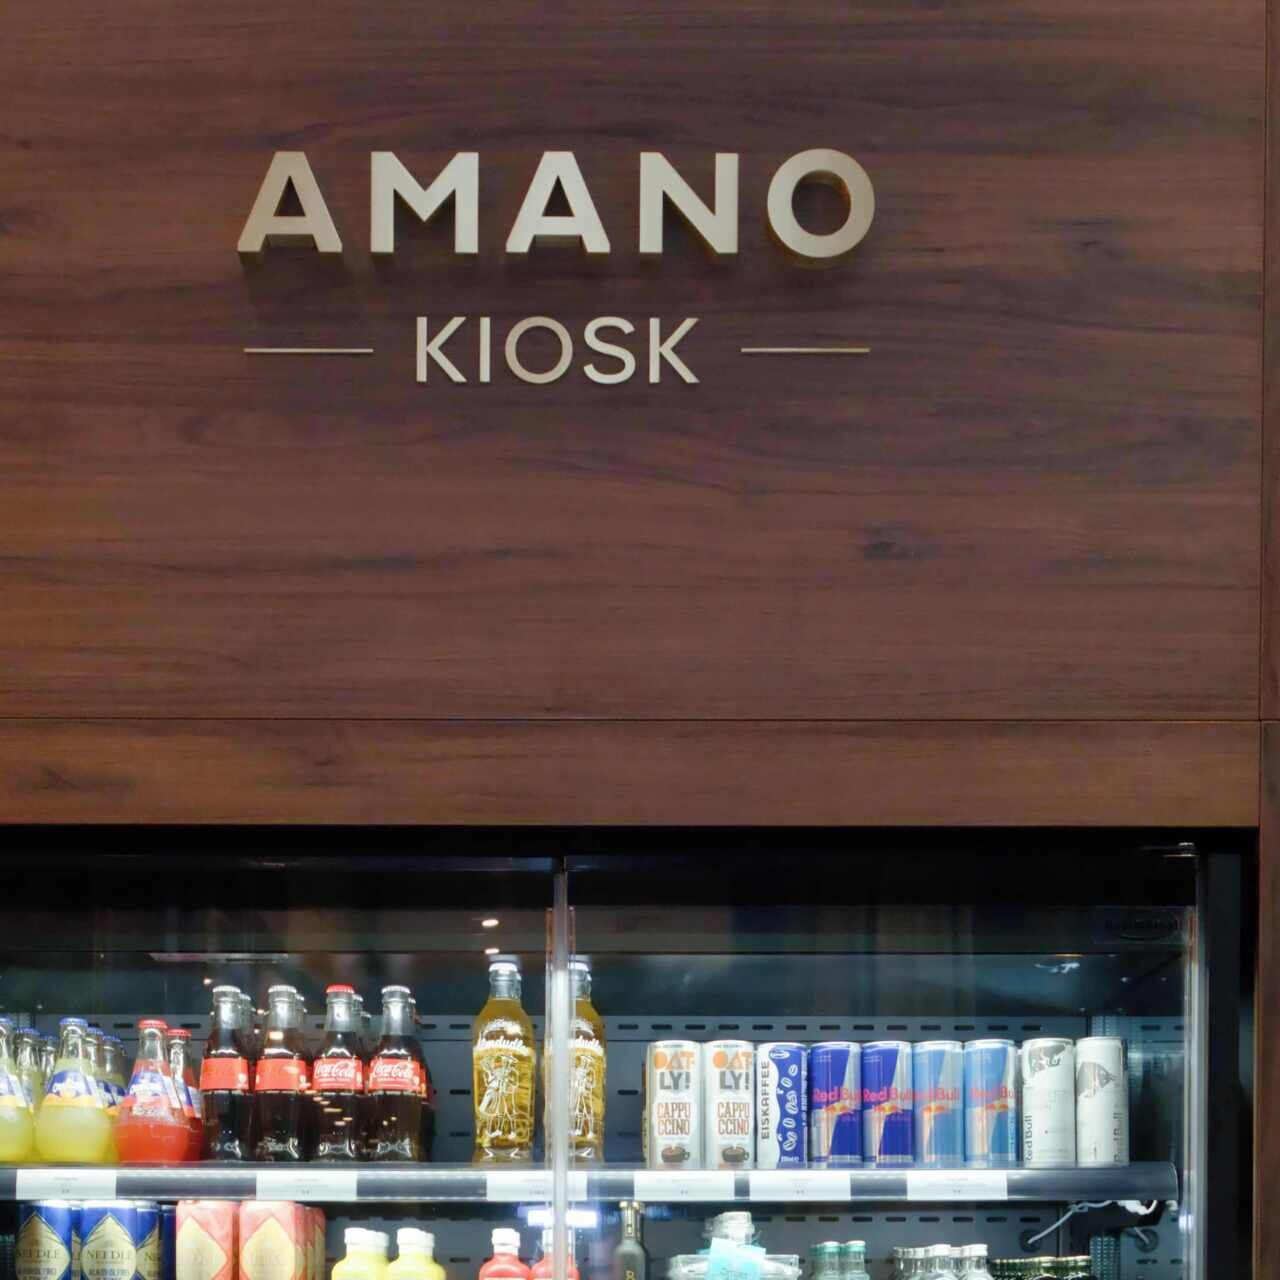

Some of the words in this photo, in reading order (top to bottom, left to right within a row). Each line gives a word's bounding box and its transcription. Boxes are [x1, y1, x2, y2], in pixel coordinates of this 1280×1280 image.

[236, 147, 876, 259] AMANO
[415, 315, 701, 385] KIOSK
[659, 1071, 691, 1090] LY!
[720, 1071, 750, 1090] LY!
[760, 1060, 770, 1140] EISKAFFEE
[813, 1086, 838, 1101] Red
[863, 1086, 889, 1101] Red
